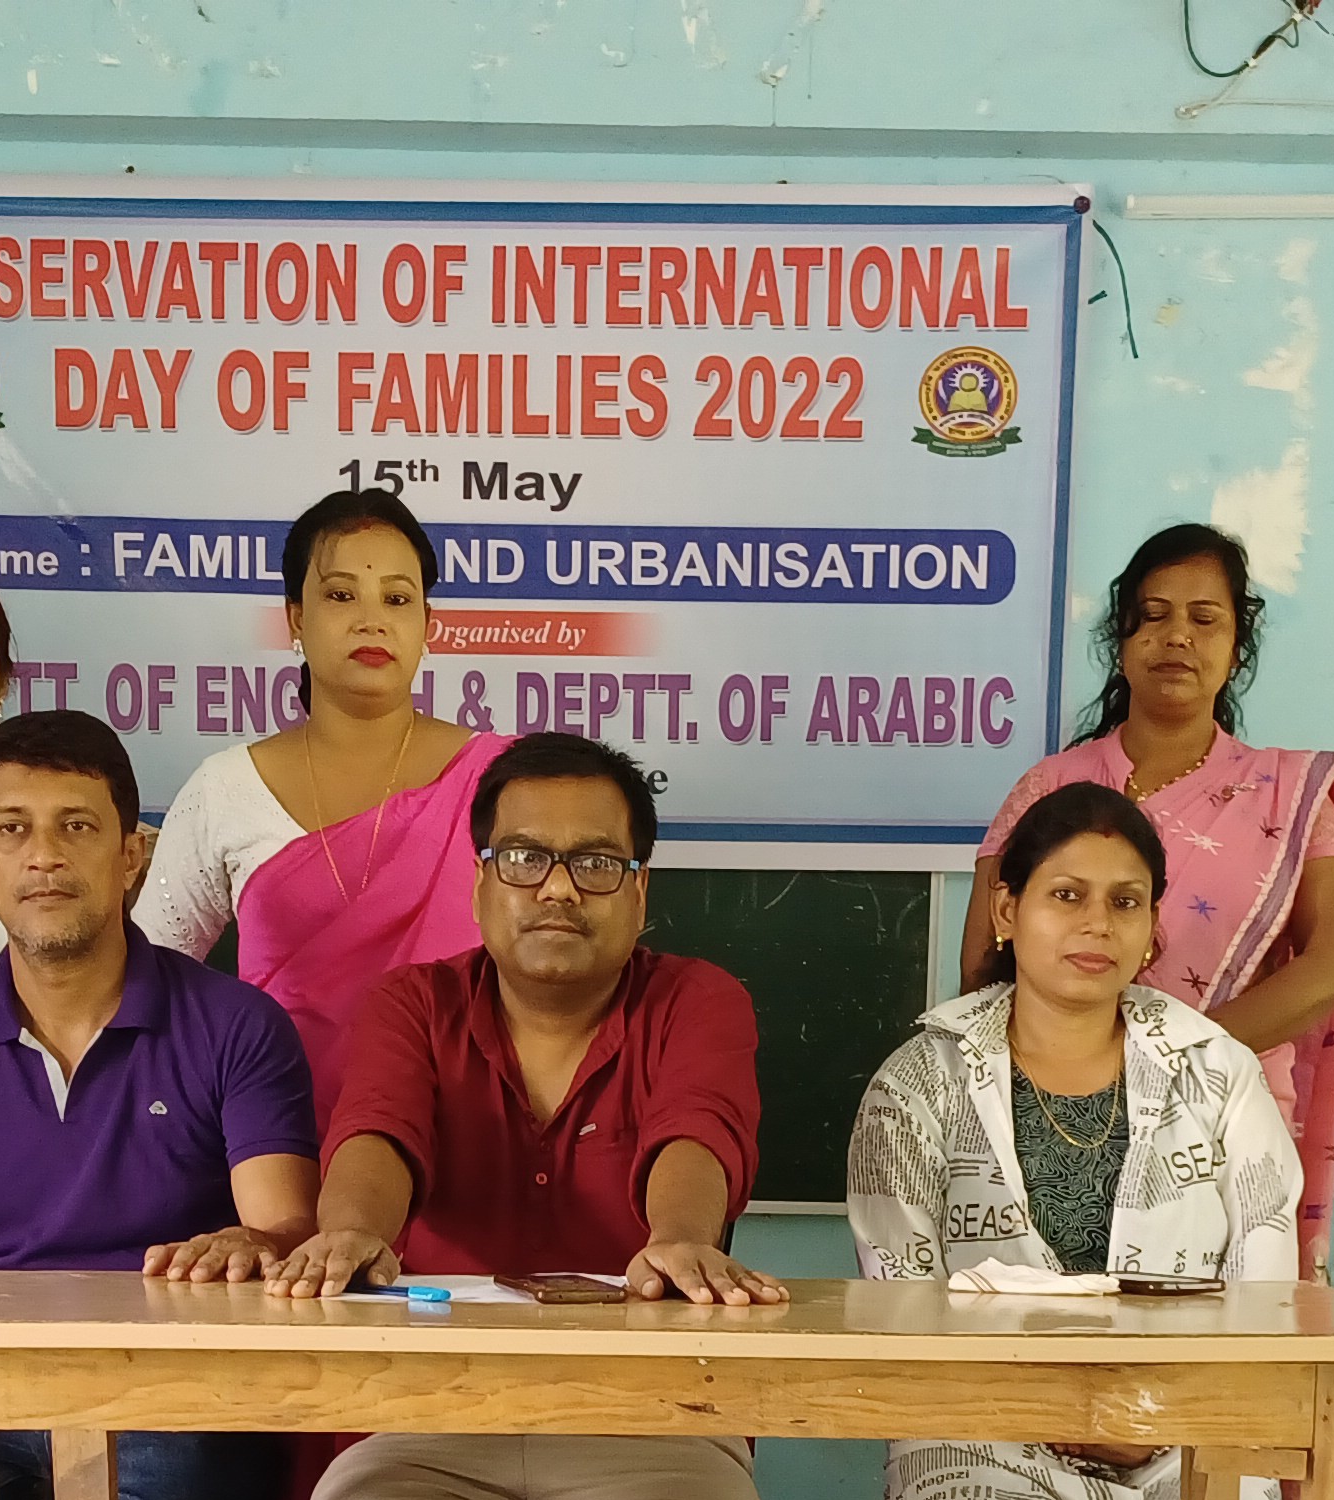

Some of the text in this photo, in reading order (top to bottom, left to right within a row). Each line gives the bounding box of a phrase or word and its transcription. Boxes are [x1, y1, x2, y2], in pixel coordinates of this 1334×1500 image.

[382, 243, 467, 324] OF
[492, 245, 1028, 329] INTERNATIONAL
[54, 348, 192, 430] DAY
[217, 349, 310, 432] OF
[338, 352, 669, 438] FAMILIES
[694, 355, 864, 440] 2022
[462, 461, 583, 511] May
[113, 532, 284, 580] FAMIL
[437, 538, 525, 583] ND
[546, 540, 988, 590] URBANISATION
[427, 618, 586, 651] Organised by
[105, 663, 177, 733] OF
[456, 670, 495, 733] &
[516, 671, 698, 741] DEPTT.
[718, 674, 790, 744] OF
[807, 677, 1015, 746] ARABIC
